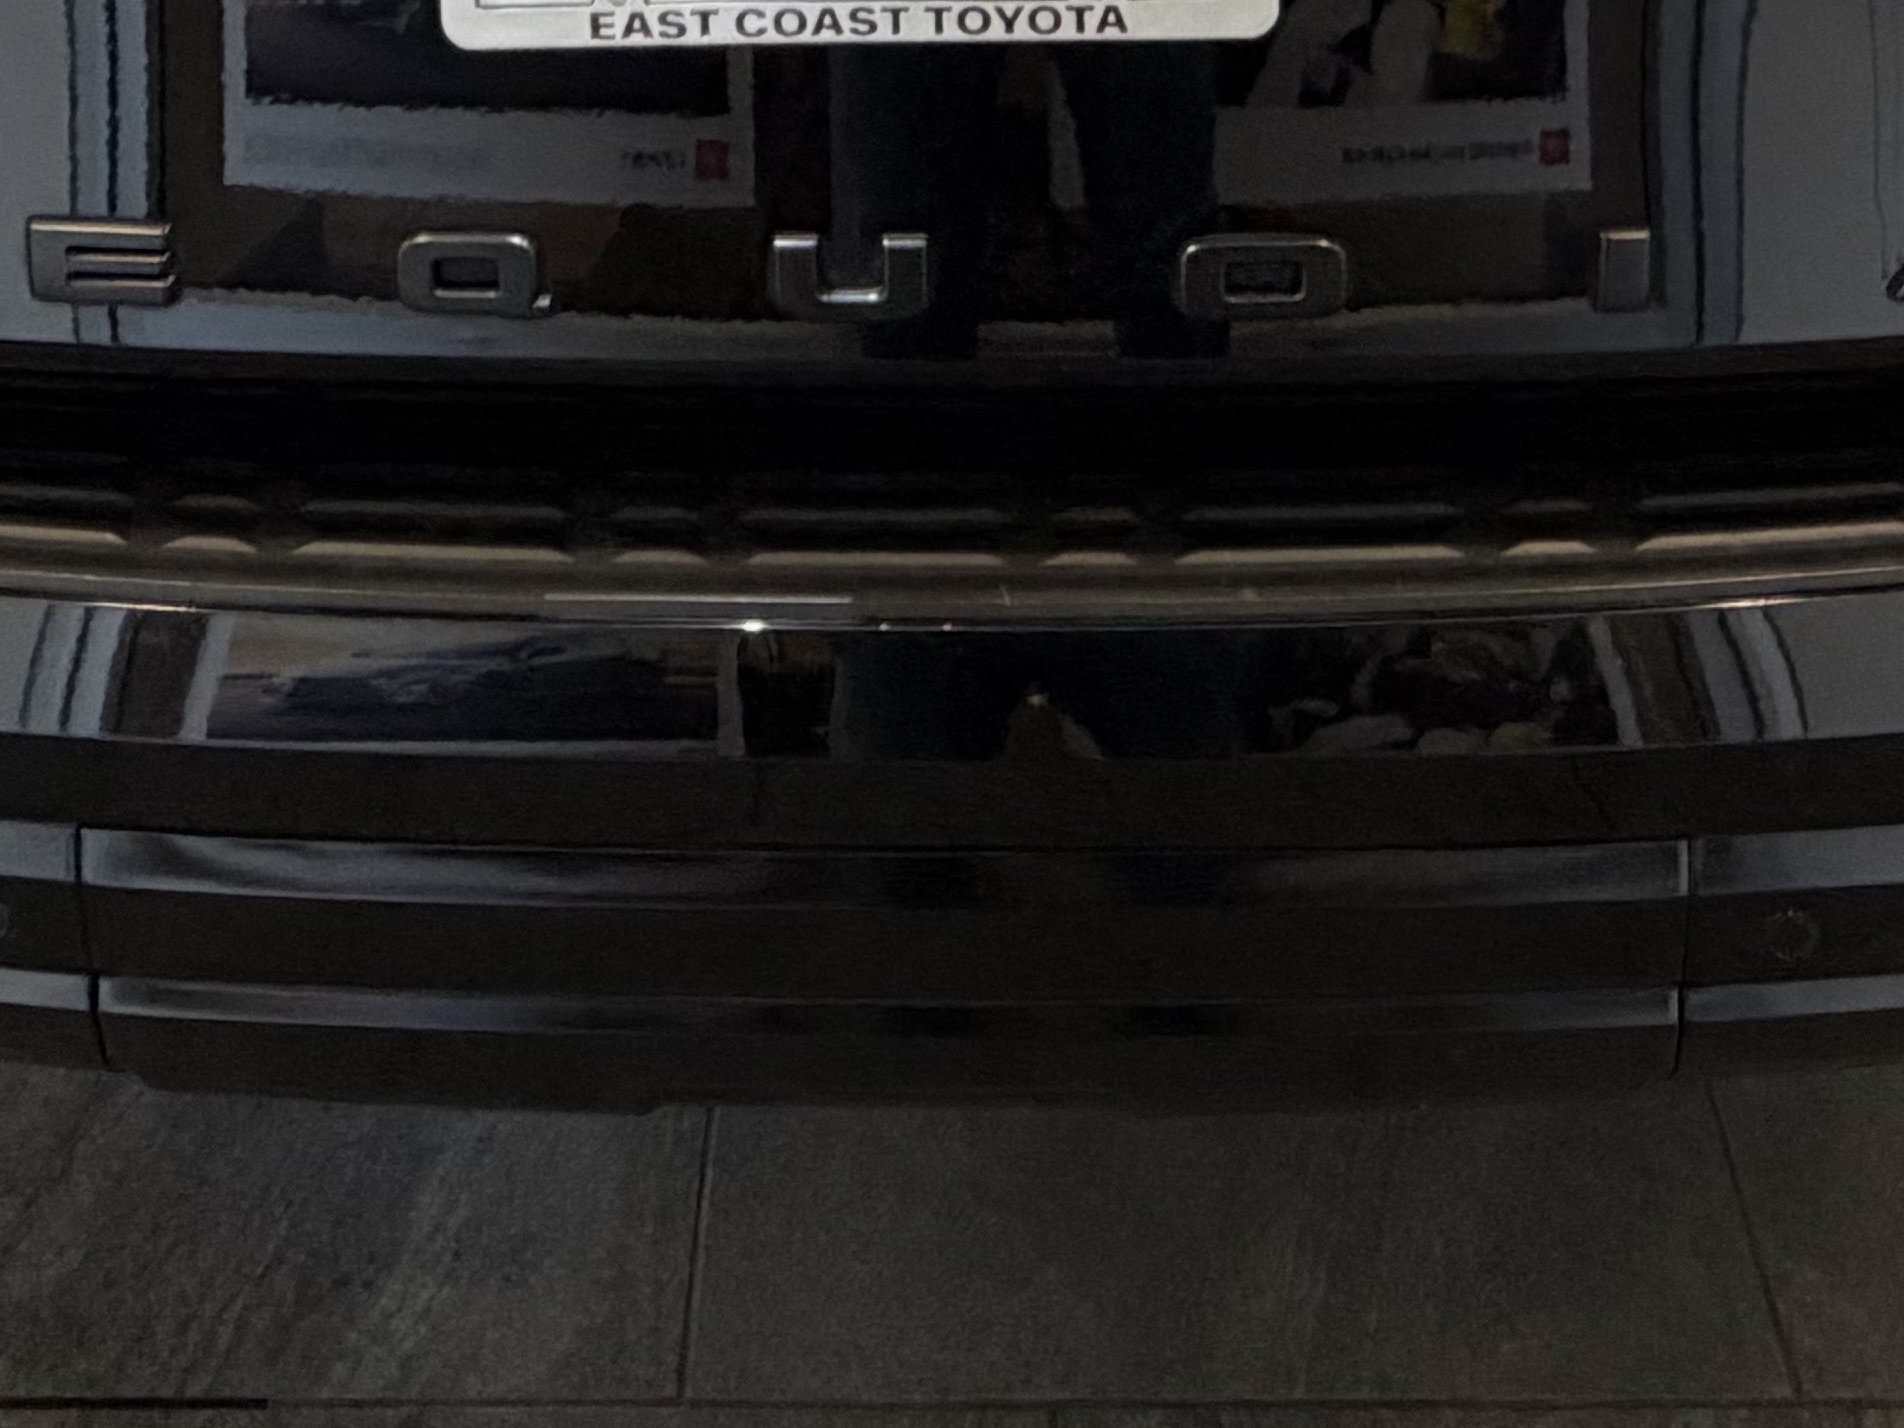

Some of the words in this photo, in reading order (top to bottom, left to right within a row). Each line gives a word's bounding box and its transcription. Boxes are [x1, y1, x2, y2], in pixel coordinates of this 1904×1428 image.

[588, 7, 721, 41] EAST
[733, 5, 911, 39] COAST
[922, 4, 1130, 37] TOYOTA
